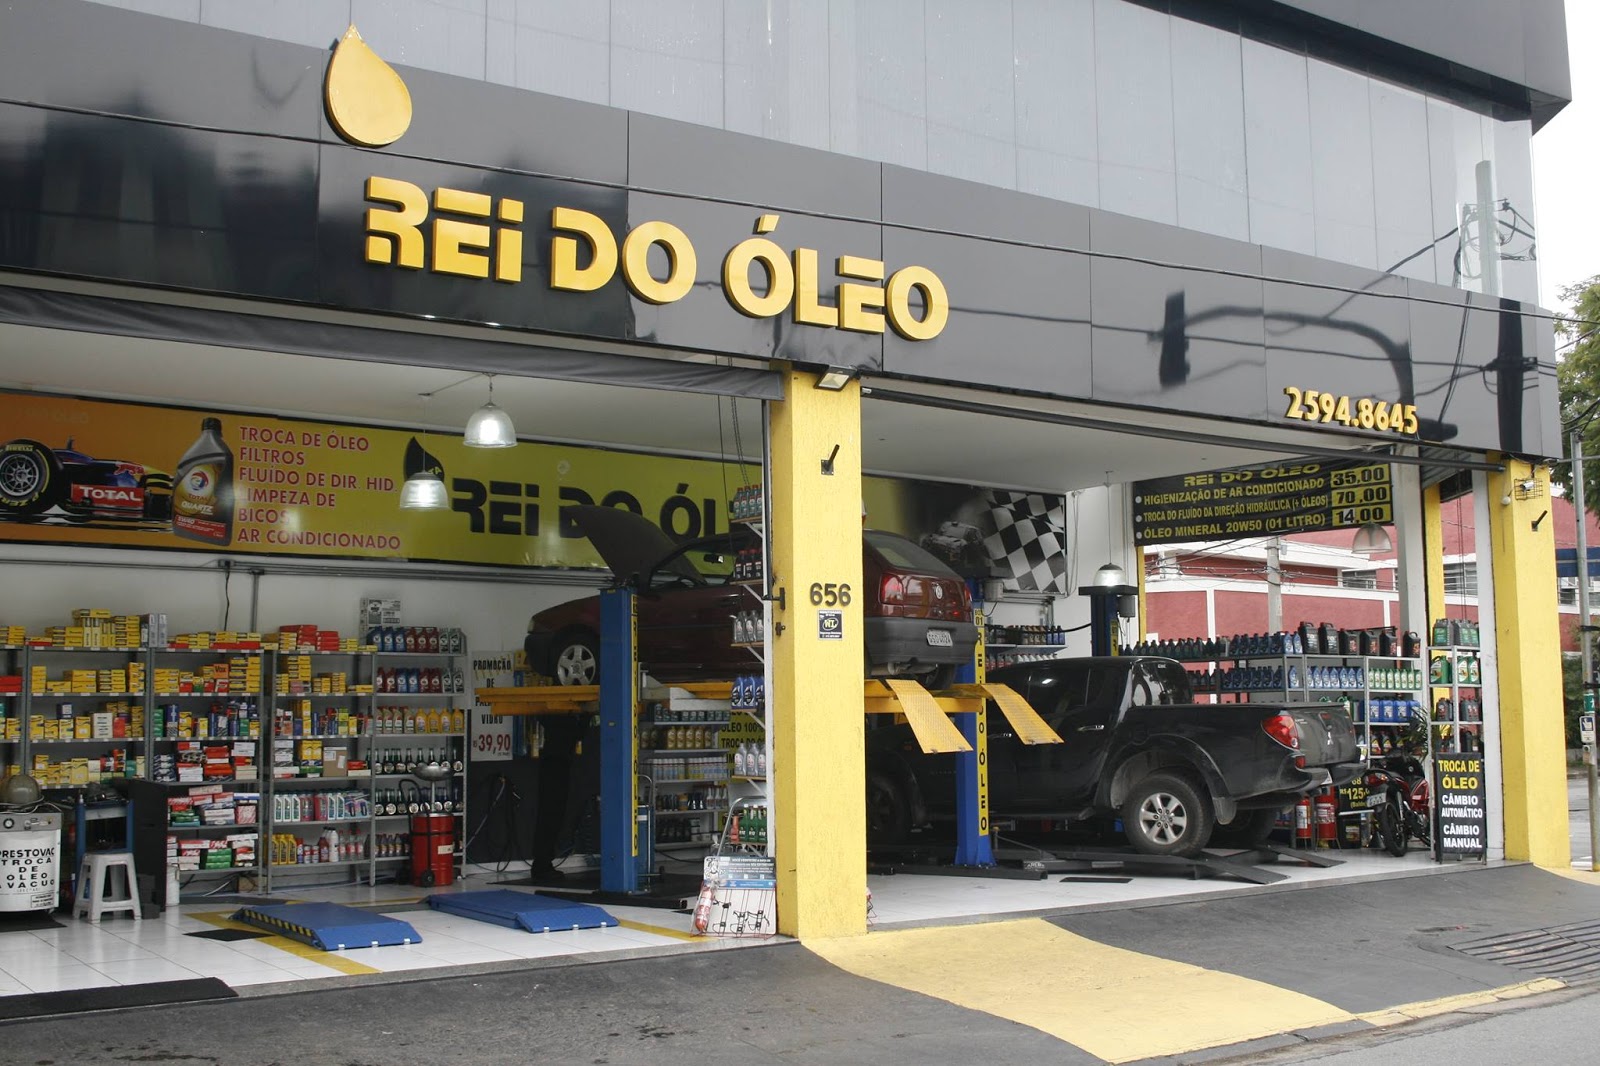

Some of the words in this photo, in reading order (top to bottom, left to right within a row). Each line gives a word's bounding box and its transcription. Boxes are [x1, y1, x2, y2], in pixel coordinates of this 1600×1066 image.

[365, 175, 524, 283] REI
[549, 206, 697, 305] DO
[724, 214, 949, 341] ÓLEO
[1284, 386, 1418, 435] 2594.8645
[240, 427, 296, 445] TROCA
[302, 432, 321, 447] DE
[327, 430, 369, 451] ÓLEO
[239, 447, 305, 466] FILTROS
[239, 465, 300, 485] FLUÍDO
[306, 472, 325, 487] DE
[331, 474, 361, 490] DIR.
[366, 477, 398, 492] HID.
[1184, 474, 1215, 487] REI
[1220, 471, 1253, 483] DO
[1260, 464, 1321, 479] ÓLEO
[79, 486, 141, 500] TOTAL
[241, 487, 310, 505] IMPEZA
[316, 493, 335, 507] DE
[1143, 489, 1211, 505] HIGIENIZAÇÃO
[1213, 489, 1227, 499] DE
[1229, 488, 1243, 497] AR
[1245, 478, 1325, 496] CONDICIONADO
[181, 500, 214, 512] QUARTZ
[452, 477, 540, 536] REI
[1143, 511, 1165, 522] TROCA
[1167, 510, 1177, 520] DO
[1178, 506, 1202, 519] FLUÍDO
[1203, 508, 1213, 518] DA
[1215, 503, 1245, 518] DIREÇÃO
[1246, 501, 1291, 513] HIDRÁULICA
[1301, 495, 1328, 508] ÓLEOS)
[238, 508, 290, 524] BICOS
[1143, 526, 1172, 539] ÓLEO
[1175, 524, 1223, 536] MINERAL
[1225, 520, 1262, 533] 20W50
[1265, 519, 1282, 531] (01
[1286, 514, 1326, 527] LITRO)
[237, 528, 260, 543] AR
[266, 530, 401, 550] CONDICIONADO
[809, 582, 852, 607] 656
[975, 616, 984, 626] 01
[486, 678, 496, 688] DE
[478, 734, 511, 754] 39,90
[1438, 760, 1467, 772] TROCA
[1468, 760, 1480, 772] DE
[978, 747, 987, 831] ÓLEO
[1442, 774, 1478, 789] ÓLEO
[1441, 793, 1478, 805] CÂMBIO
[1441, 806, 1483, 818] AUTOMÁTICO
[1443, 823, 1480, 835] CÂMBIO
[1443, 838, 1483, 848] MANUAL
[2, 857, 52, 866] TROCA
[6, 872, 48, 881] OLEO
[7, 879, 55, 888] VACUO
